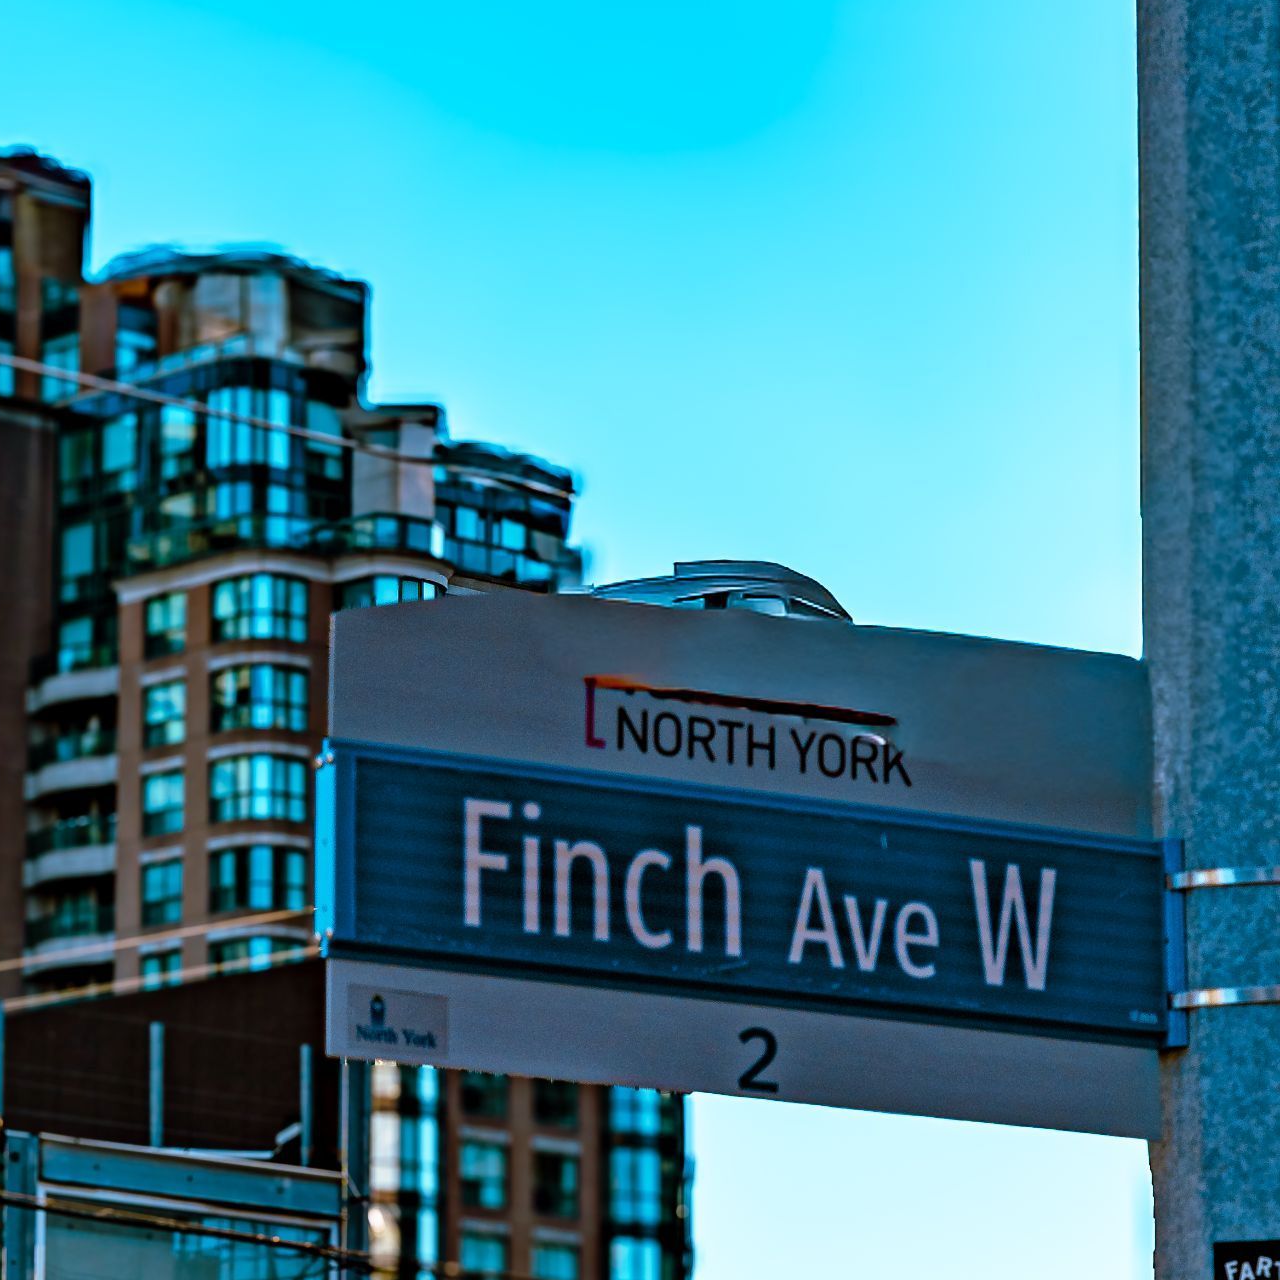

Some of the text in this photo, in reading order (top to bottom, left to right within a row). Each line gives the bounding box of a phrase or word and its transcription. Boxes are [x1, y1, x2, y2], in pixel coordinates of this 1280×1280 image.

[617, 706, 912, 787] NORTH YORK
[462, 798, 1058, 991] Finch Ave W
[355, 1023, 437, 1049] North York
[737, 1027, 780, 1095] 2
